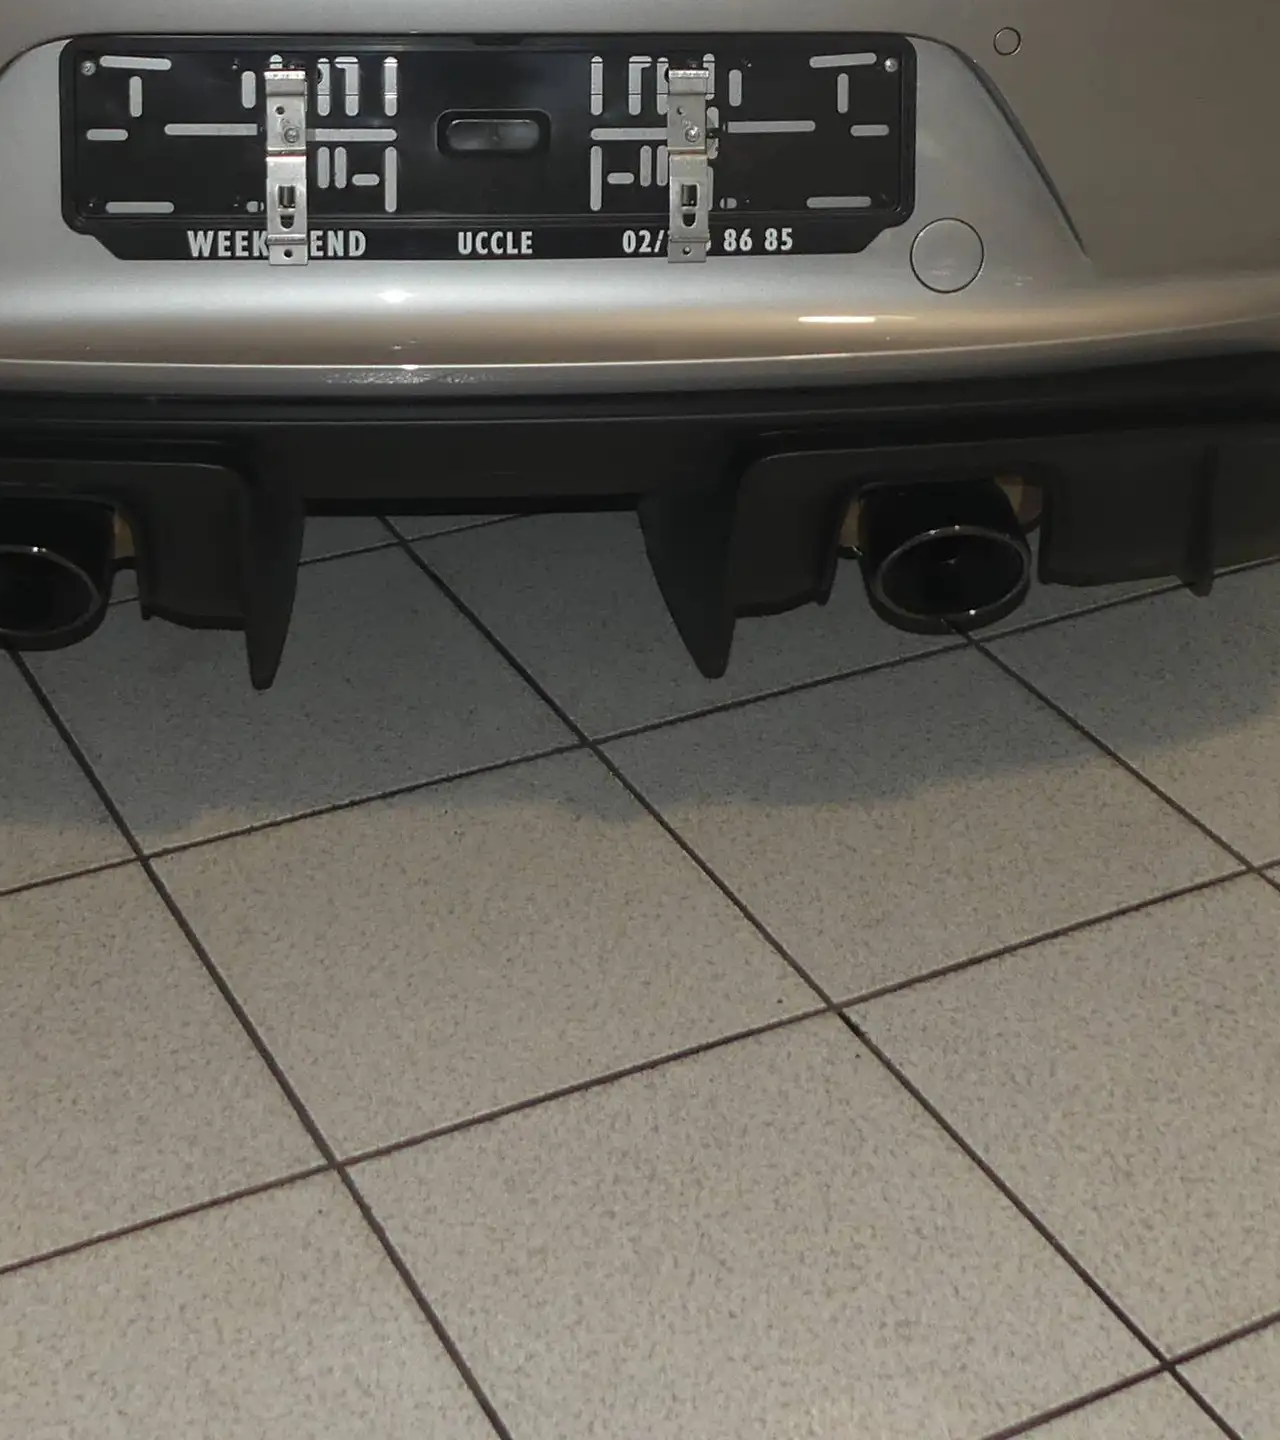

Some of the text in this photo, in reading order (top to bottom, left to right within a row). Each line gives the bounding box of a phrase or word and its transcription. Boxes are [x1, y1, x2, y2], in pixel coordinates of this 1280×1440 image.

[457, 230, 534, 255] UCCLE
[723, 227, 753, 252] 86
[764, 227, 794, 251] 85
